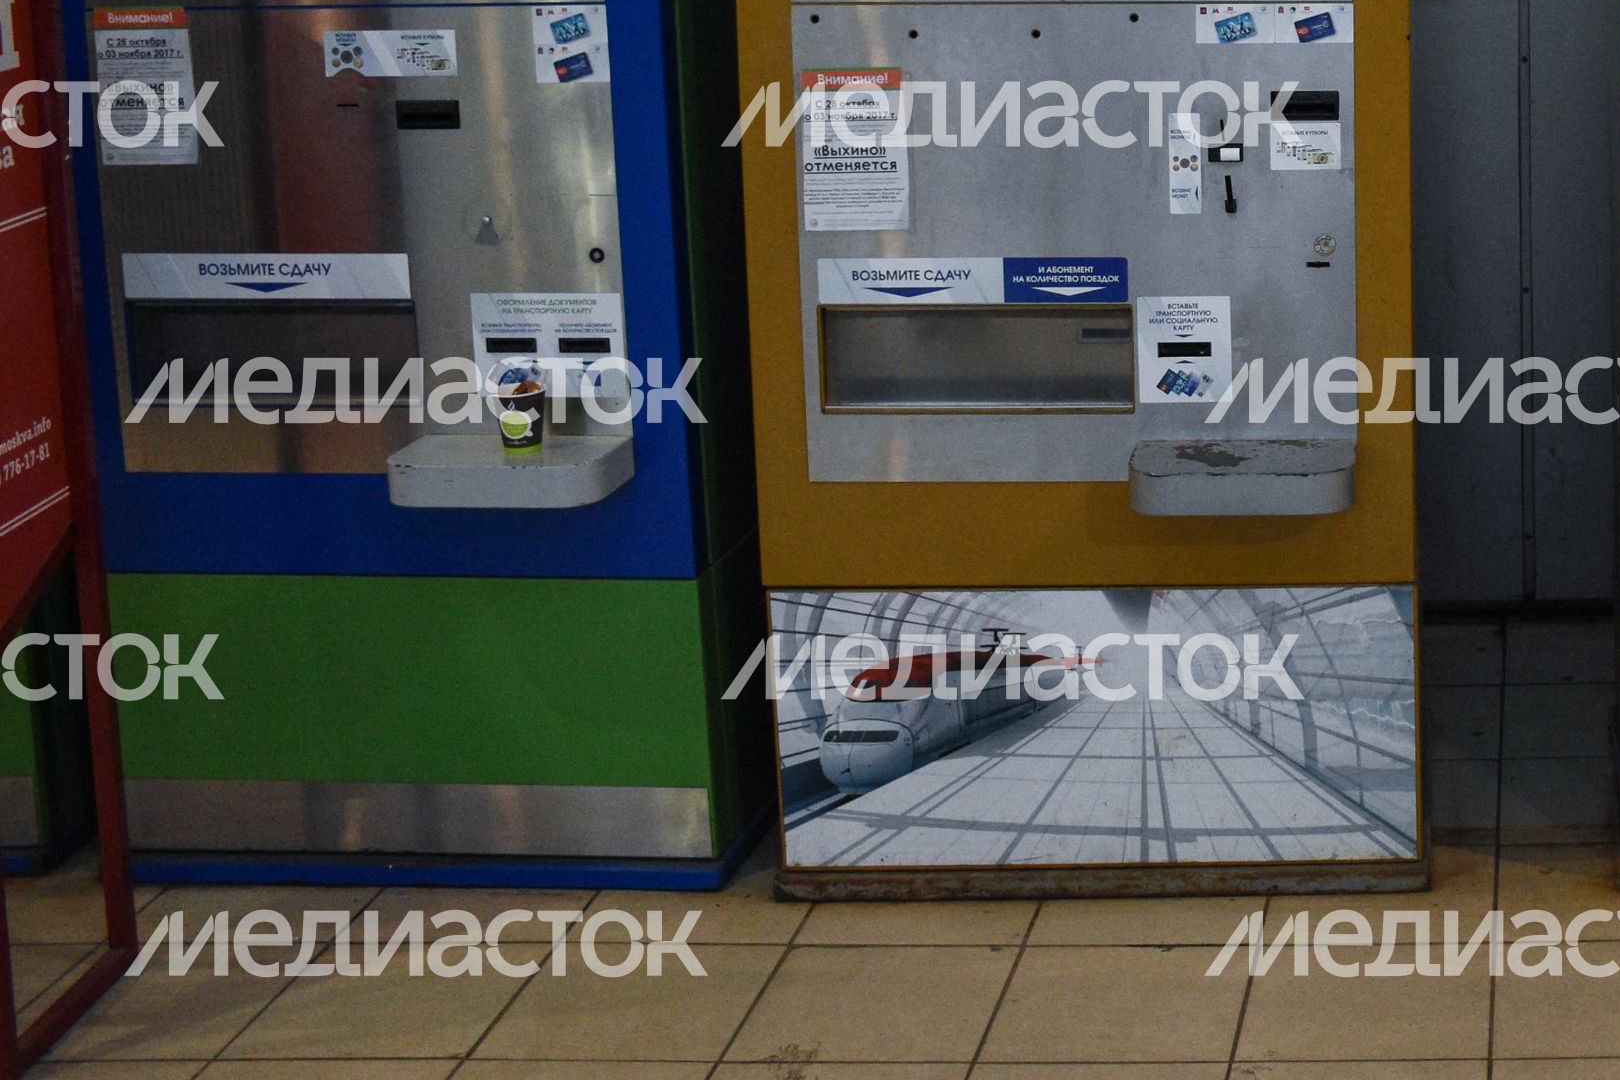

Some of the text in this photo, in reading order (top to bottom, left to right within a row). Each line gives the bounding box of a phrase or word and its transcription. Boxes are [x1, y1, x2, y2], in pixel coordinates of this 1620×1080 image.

[107, 11, 173, 25] Внимание!
[816, 72, 889, 86] Внимание!
[804, 159, 898, 172] отменяется
[197, 261, 332, 279] ВОЗЬМИТЕ СДАЧУ
[851, 269, 972, 283] ВОЗЬМИТЕ СДАЧУ
[1045, 266, 1094, 274] АБОНЕМЕНТ
[1026, 274, 1120, 284] КОЛИЧЕСТВО ПОЕЗДОК
